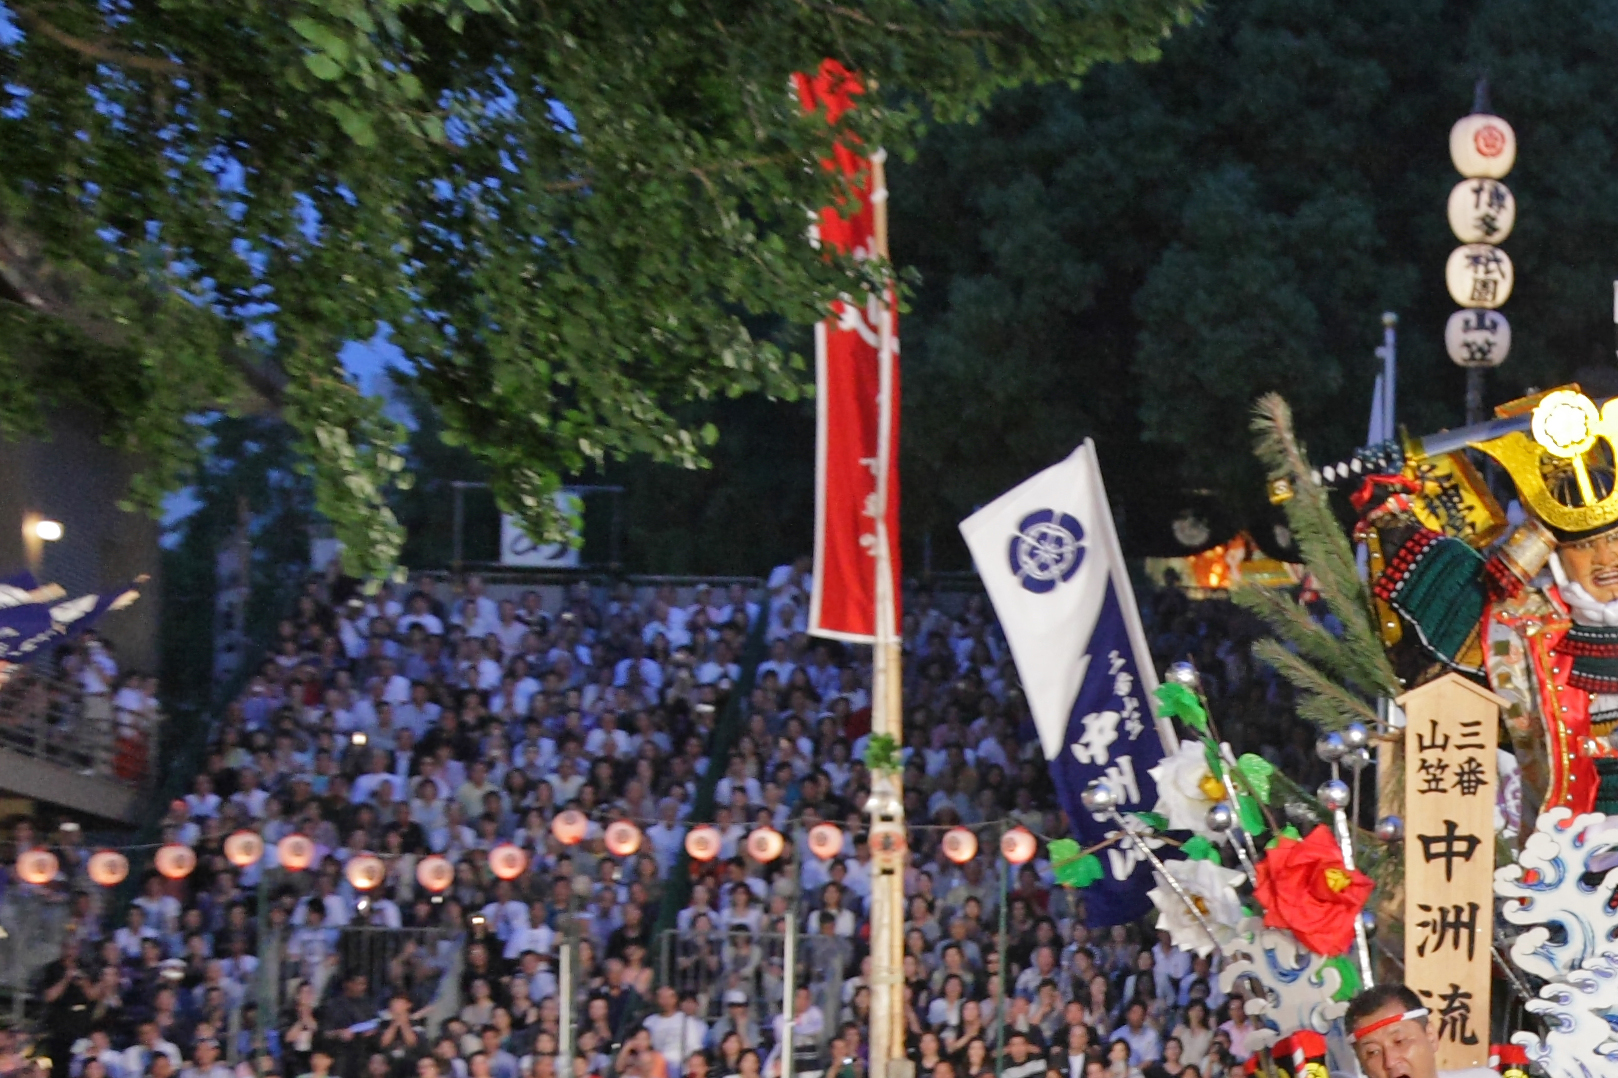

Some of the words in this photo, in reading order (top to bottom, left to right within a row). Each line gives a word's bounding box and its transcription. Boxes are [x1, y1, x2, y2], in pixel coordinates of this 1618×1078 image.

[1416, 720, 1450, 796] 山笠
[1452, 720, 1489, 797] 三番
[1415, 820, 1483, 1046] 中洲流
